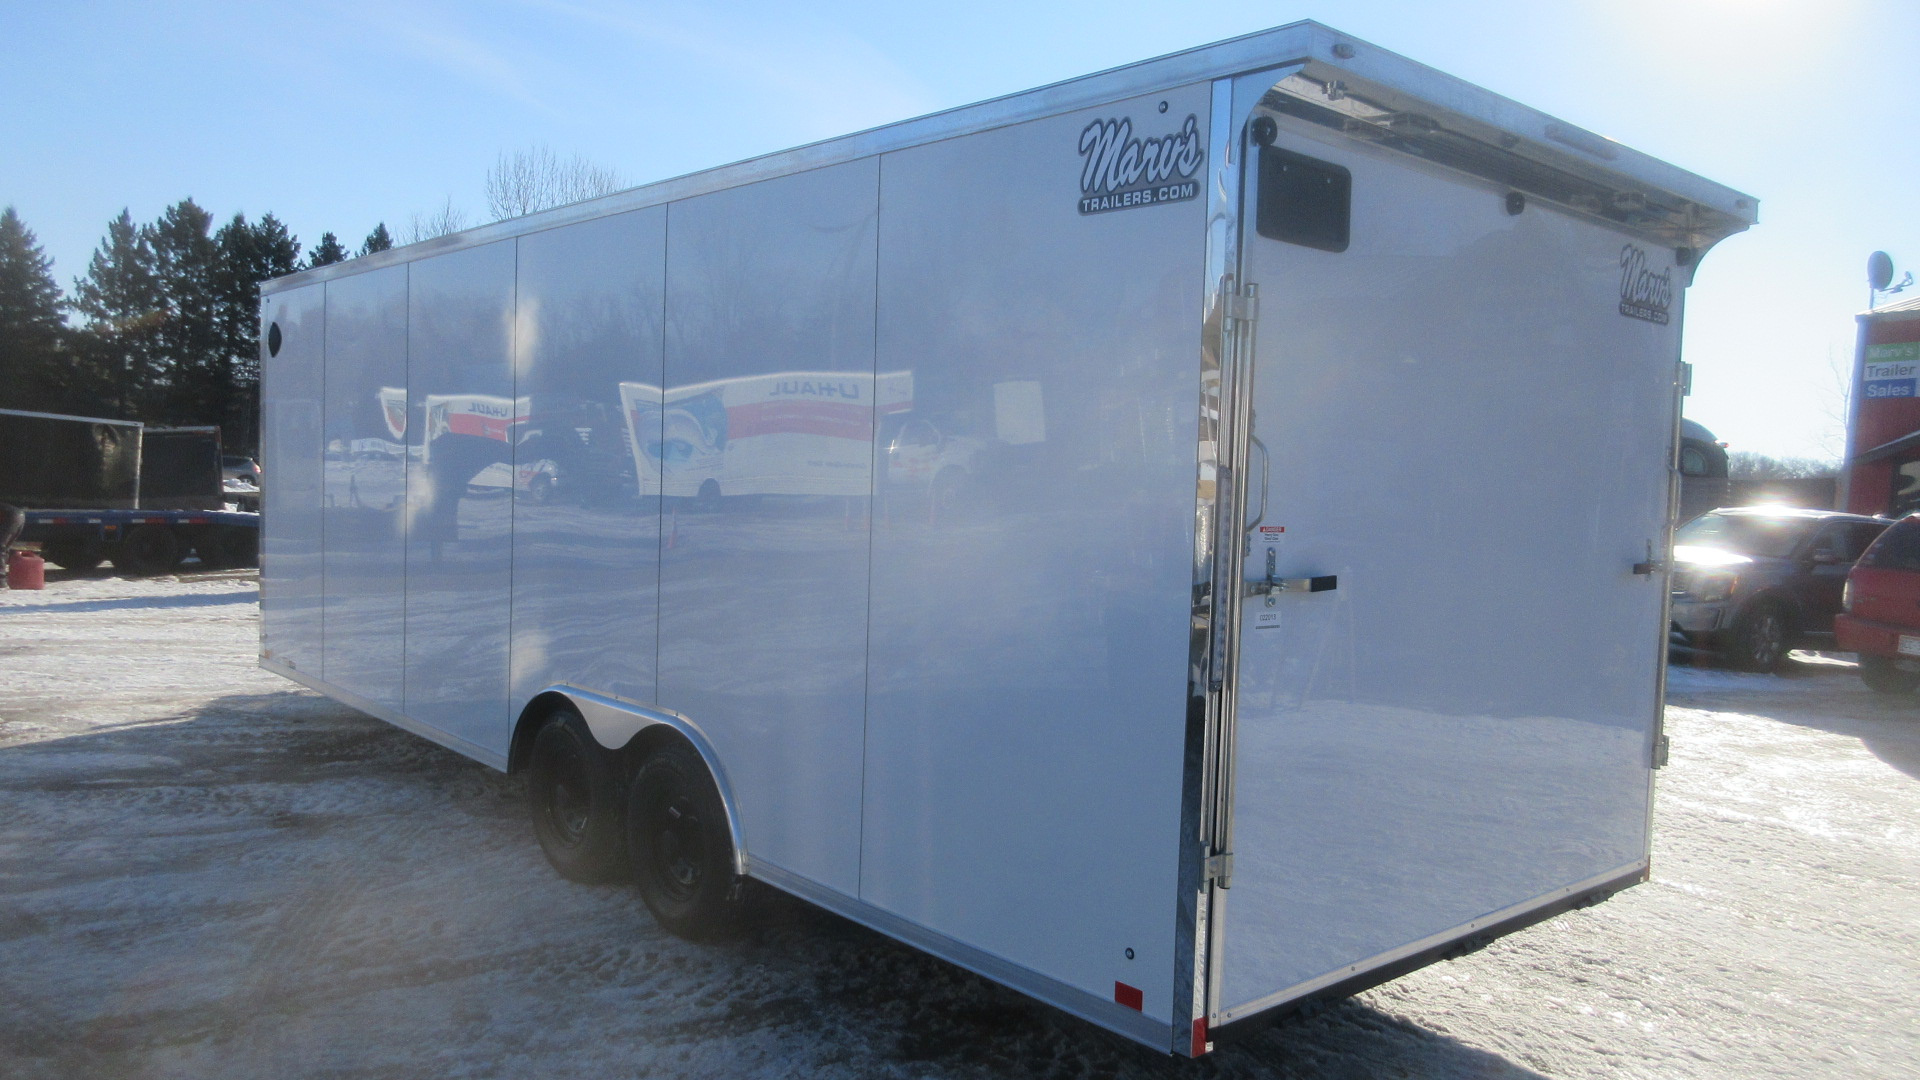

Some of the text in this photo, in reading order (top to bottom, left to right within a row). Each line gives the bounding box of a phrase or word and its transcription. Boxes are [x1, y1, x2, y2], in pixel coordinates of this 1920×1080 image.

[1079, 114, 1204, 193] Marv's
[1082, 183, 1194, 212] TRAILERS.COM
[1866, 364, 1917, 378] Trailer
[1867, 383, 1911, 397] Sales
